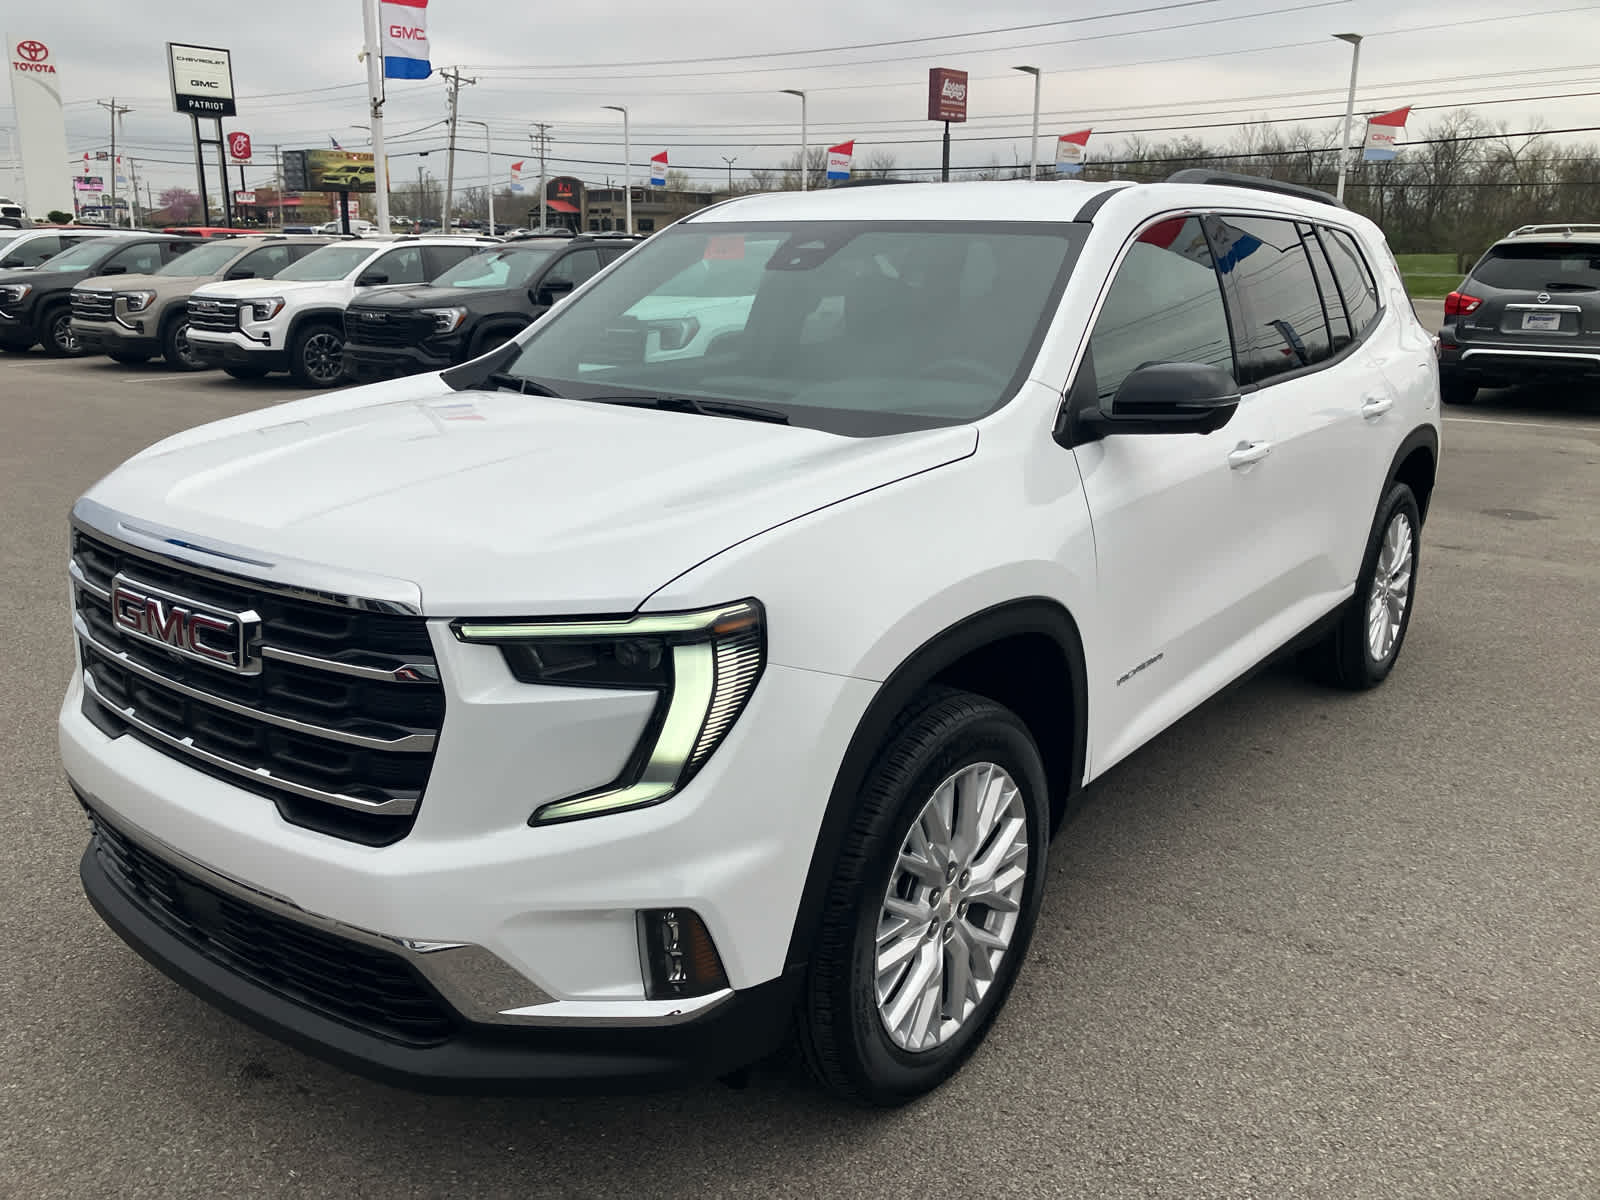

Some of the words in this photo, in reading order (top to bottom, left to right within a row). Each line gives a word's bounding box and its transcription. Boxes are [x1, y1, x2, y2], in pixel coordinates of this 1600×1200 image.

[390, 24, 426, 40] GMC
[176, 55, 225, 65] CHEVROLET
[12, 61, 56, 73] TOYOTA
[190, 79, 219, 88] GMC
[188, 99, 224, 110] PATRIOT
[113, 587, 236, 662] GMC
